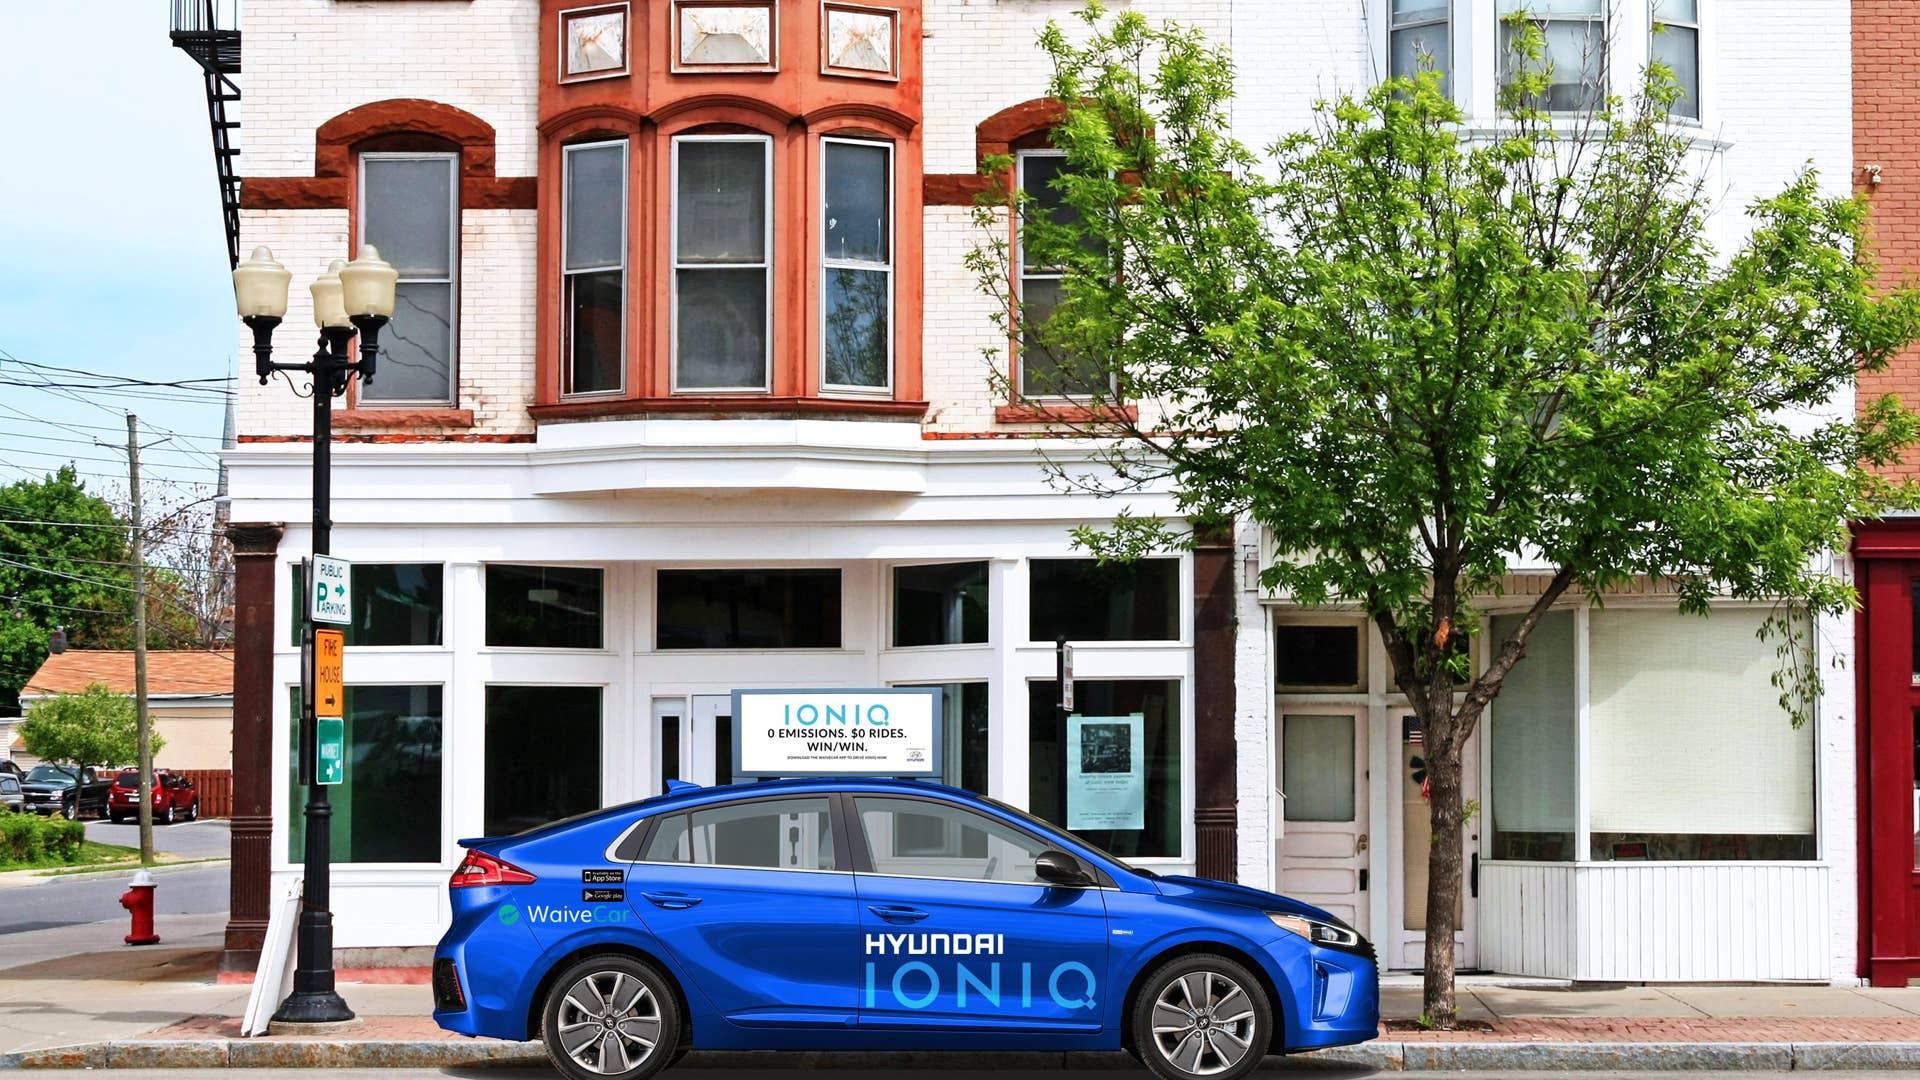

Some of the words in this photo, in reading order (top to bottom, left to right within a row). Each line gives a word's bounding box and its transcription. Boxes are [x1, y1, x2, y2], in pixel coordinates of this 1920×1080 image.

[320, 563, 343, 578] PUBLIC
[317, 582, 347, 616] PARKING
[324, 638, 338, 656] FIRE
[320, 664, 341, 683] HOUSE
[785, 704, 889, 726] IONIQ
[768, 728, 775, 738] 0
[778, 728, 847, 738] EMISSIONS.
[851, 727, 866, 739] $0
[869, 728, 907, 738] RIDES.
[807, 741, 868, 752] WIN/WIN.
[612, 892, 623, 900] play
[528, 905, 630, 923] WaiveCar
[865, 933, 1004, 955] HYUNDAI
[865, 961, 1097, 1010] IONIQ
